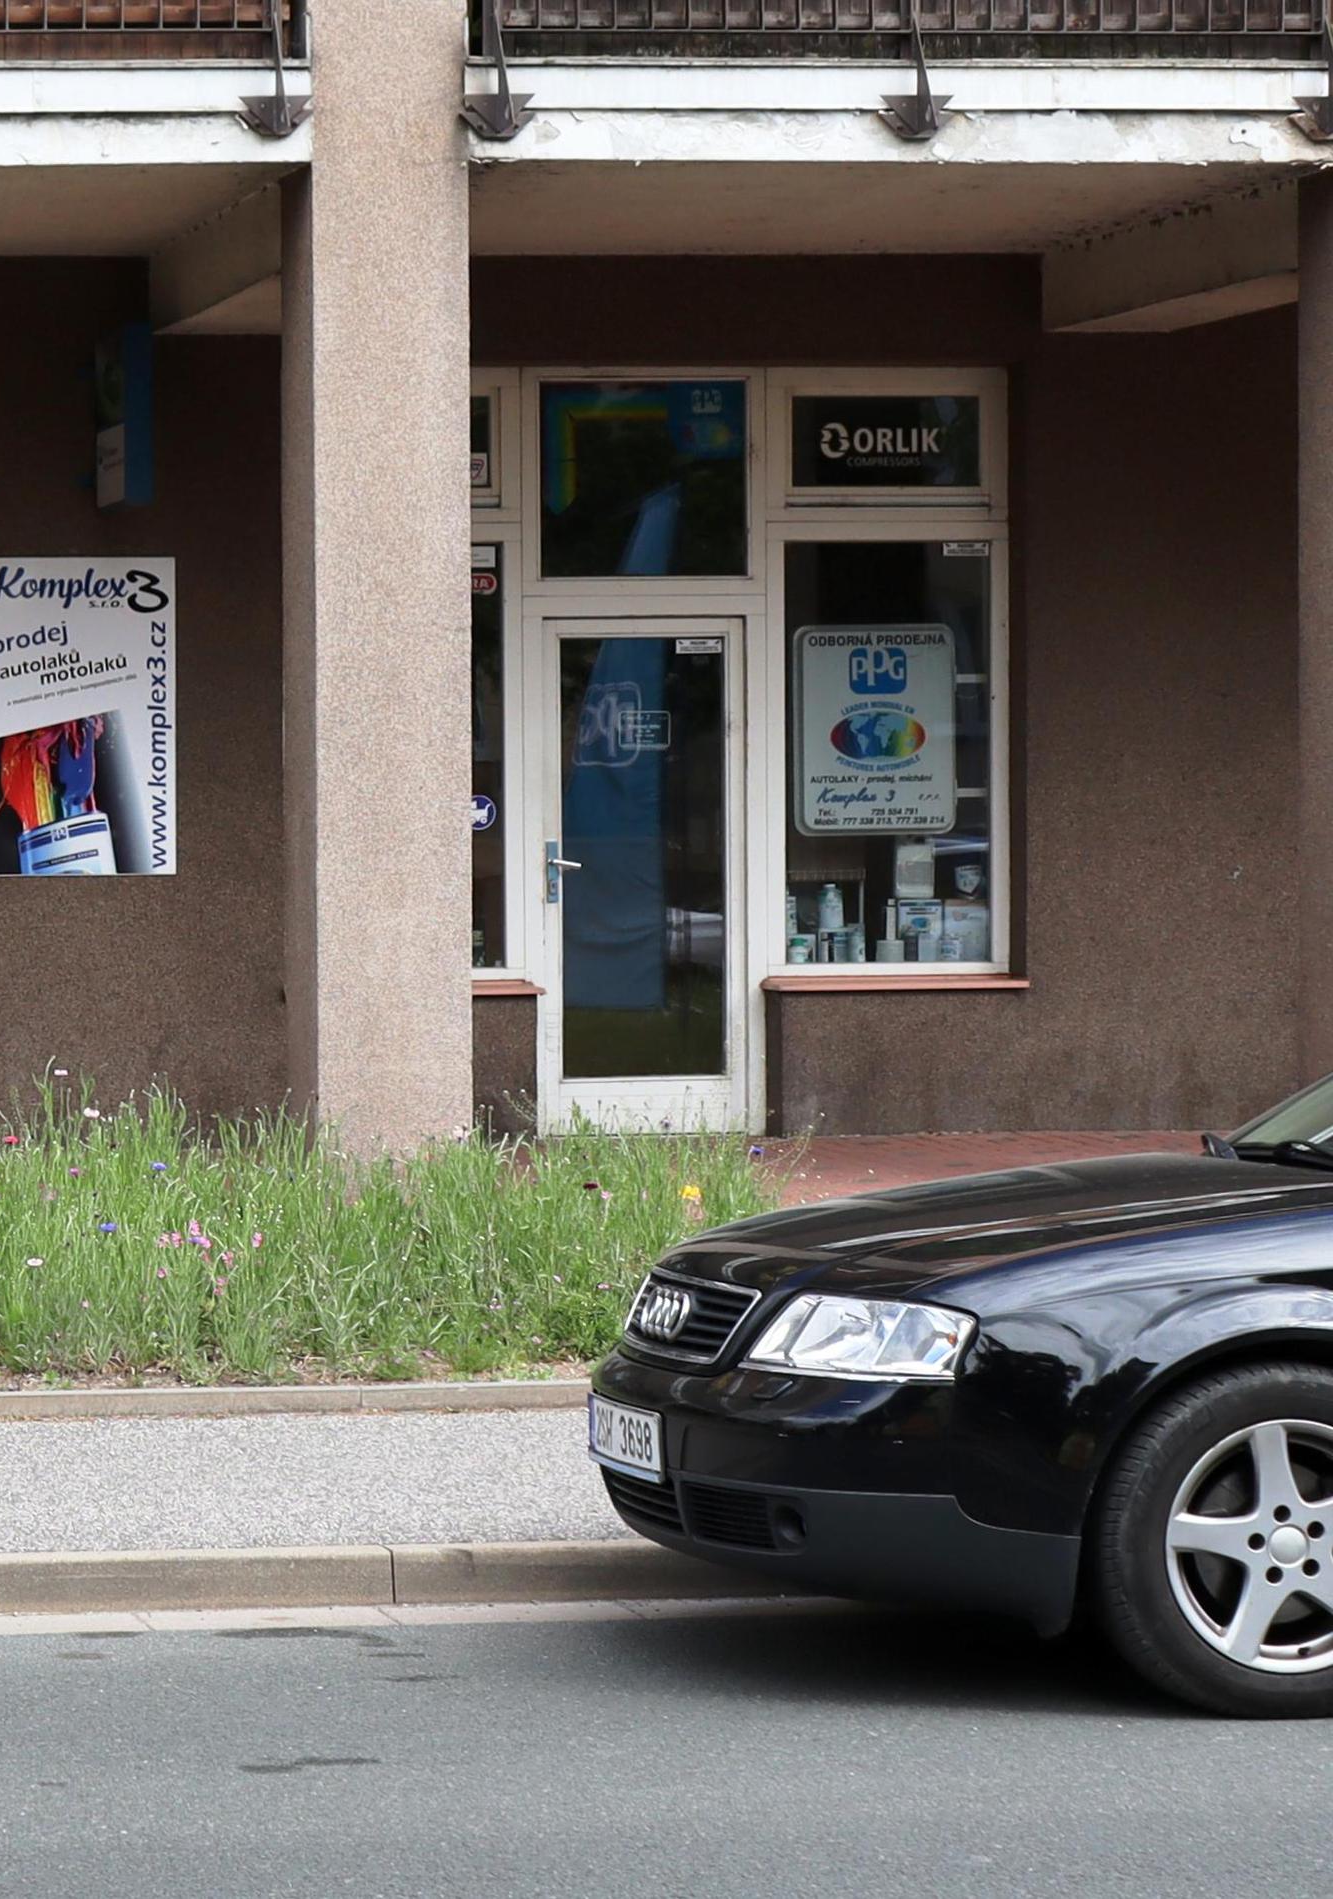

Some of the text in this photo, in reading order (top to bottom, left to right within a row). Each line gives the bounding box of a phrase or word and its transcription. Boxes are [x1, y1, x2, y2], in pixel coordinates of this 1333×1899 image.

[853, 427, 940, 453] ORLIK
[846, 457, 922, 467] COMPRESSORS
[88, 600, 125, 609] s.r.o.
[808, 632, 946, 647] ODBORNÁ PRODEJNA
[0, 648, 81, 679] autolaků
[40, 653, 128, 685] motolaků
[851, 648, 905, 687] PPG
[146, 620, 172, 868] www.komplex3.cz
[810, 775, 859, 784] AUTOLAKY
[885, 789, 896, 801] 3
[841, 817, 858, 825] 777
[895, 817, 911, 825] 777
[619, 1415, 653, 1463] 3698
